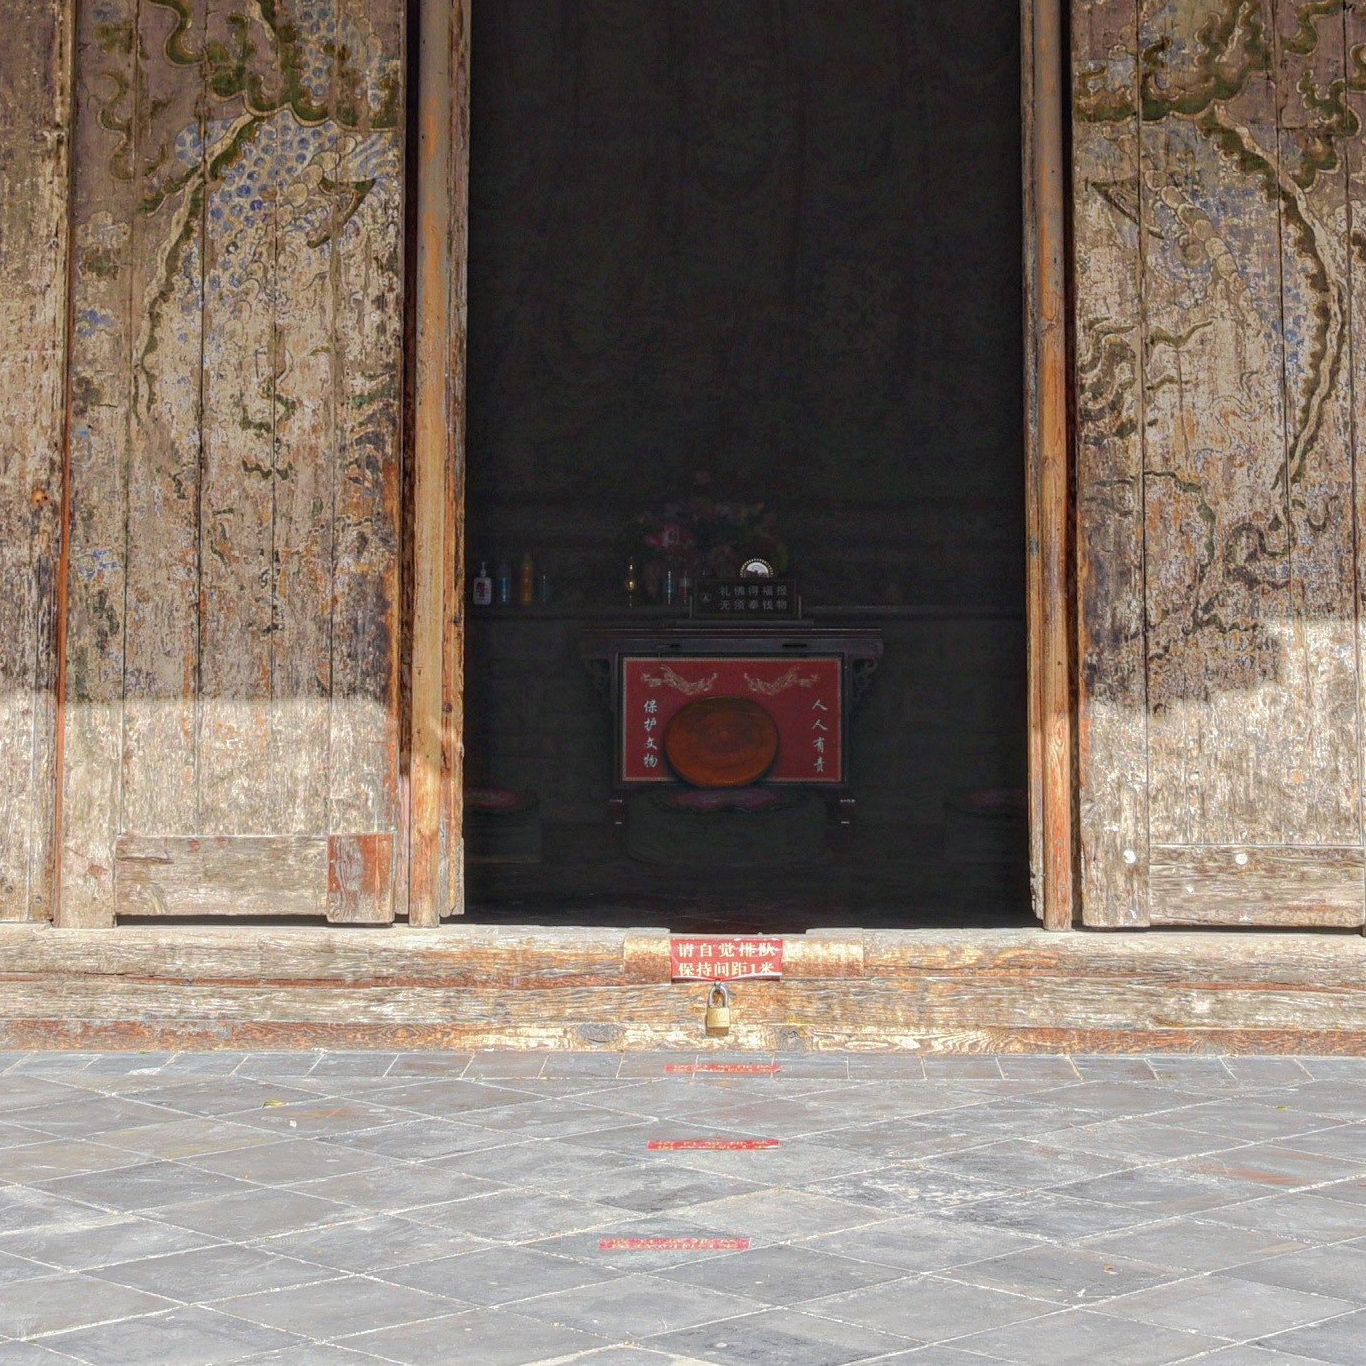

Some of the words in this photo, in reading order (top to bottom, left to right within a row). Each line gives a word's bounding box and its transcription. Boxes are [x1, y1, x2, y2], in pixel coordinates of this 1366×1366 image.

[643, 699, 659, 769] 保护文物
[812, 699, 829, 773] 人人有责
[678, 942, 777, 958] 请自觉排队
[678, 962, 775, 976] 保持间距1米
